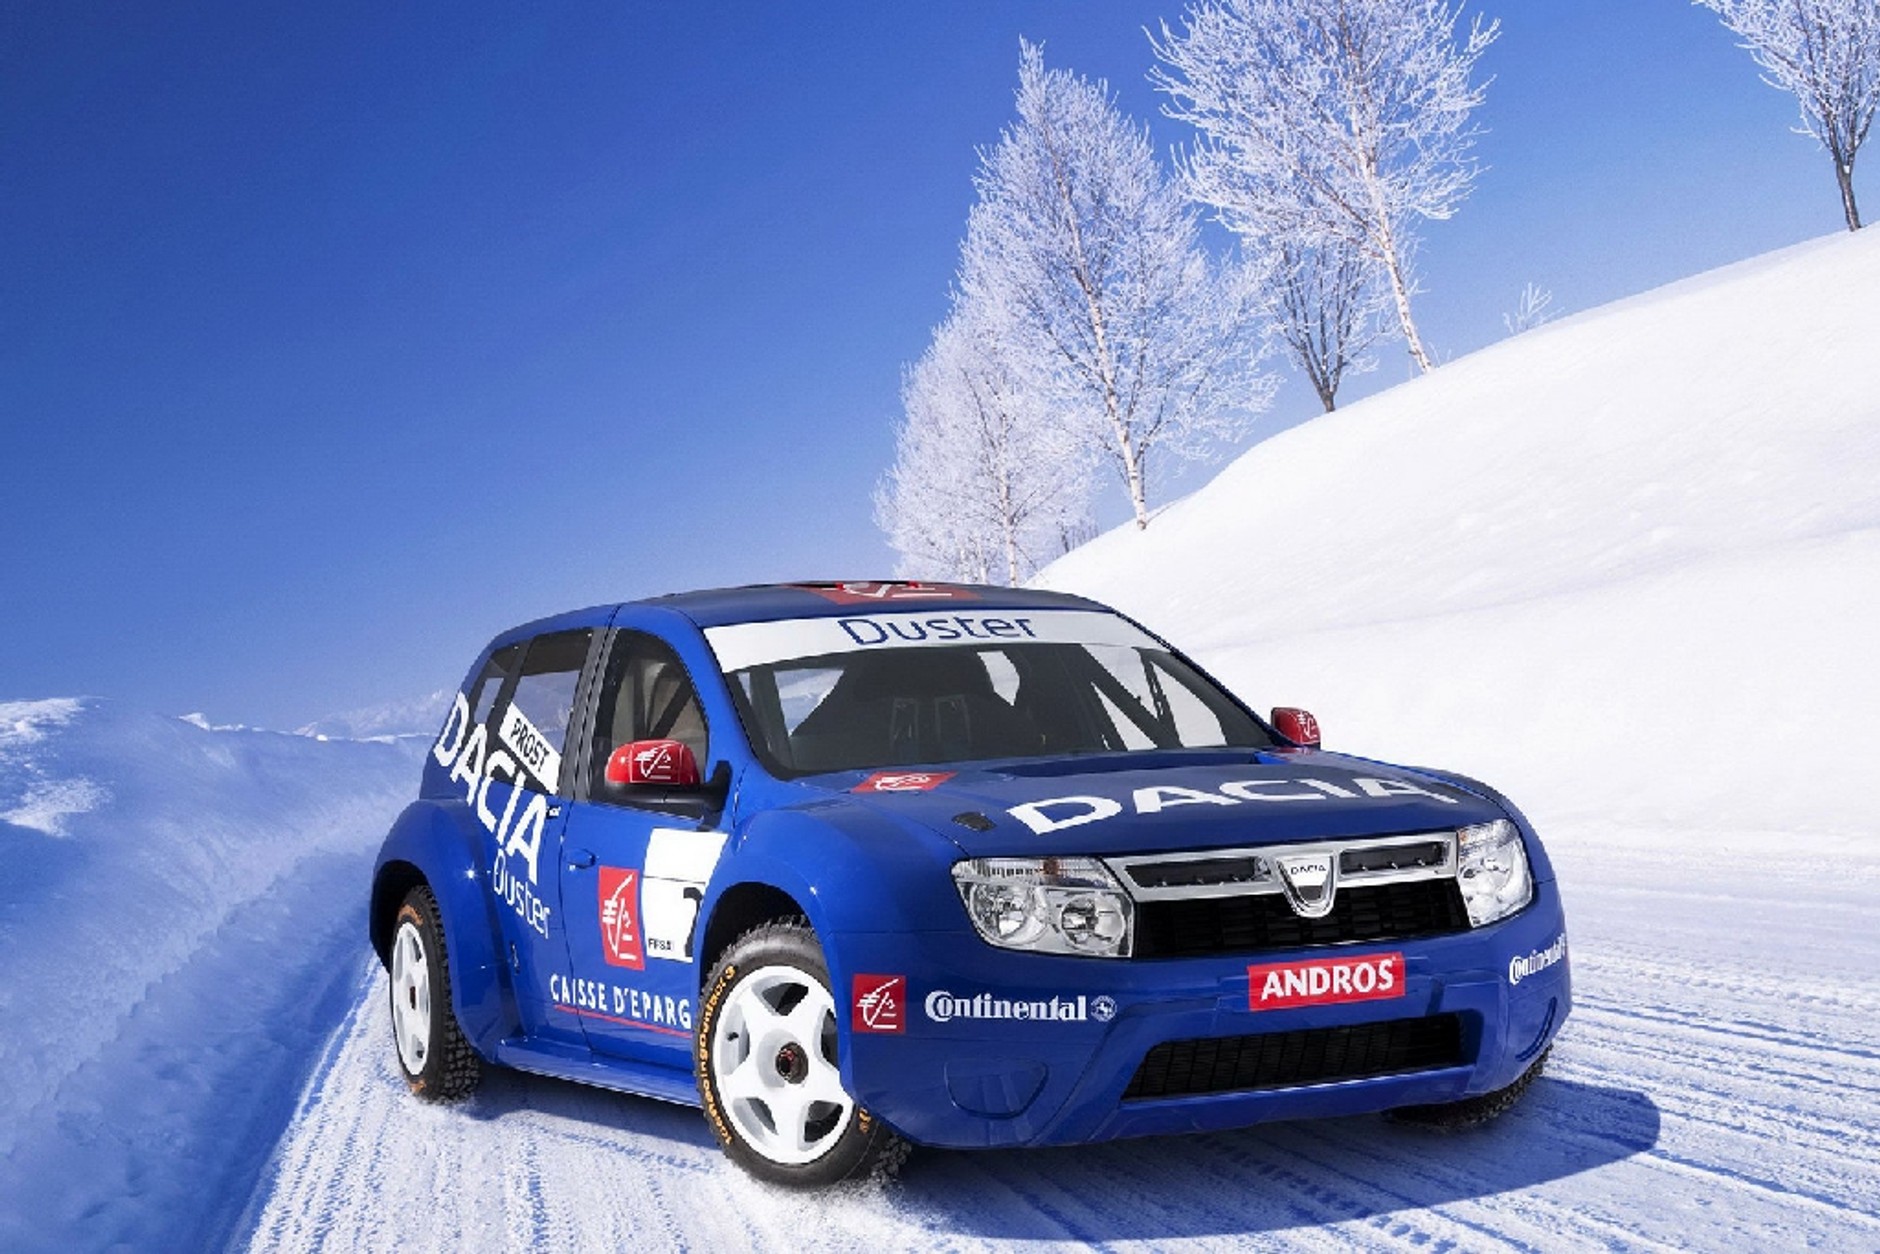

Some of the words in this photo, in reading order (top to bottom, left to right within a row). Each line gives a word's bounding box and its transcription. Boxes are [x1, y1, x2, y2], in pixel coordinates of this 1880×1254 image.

[837, 616, 1036, 645] Duster
[511, 718, 550, 772] PROST
[433, 690, 547, 885] DACIA
[1006, 777, 1458, 835] DACIA
[1290, 864, 1327, 875] DACIA
[493, 848, 550, 939] Duster
[550, 973, 607, 1011] CAISSE
[1261, 958, 1393, 1001] ANDROS
[925, 990, 1088, 1022] Continental
